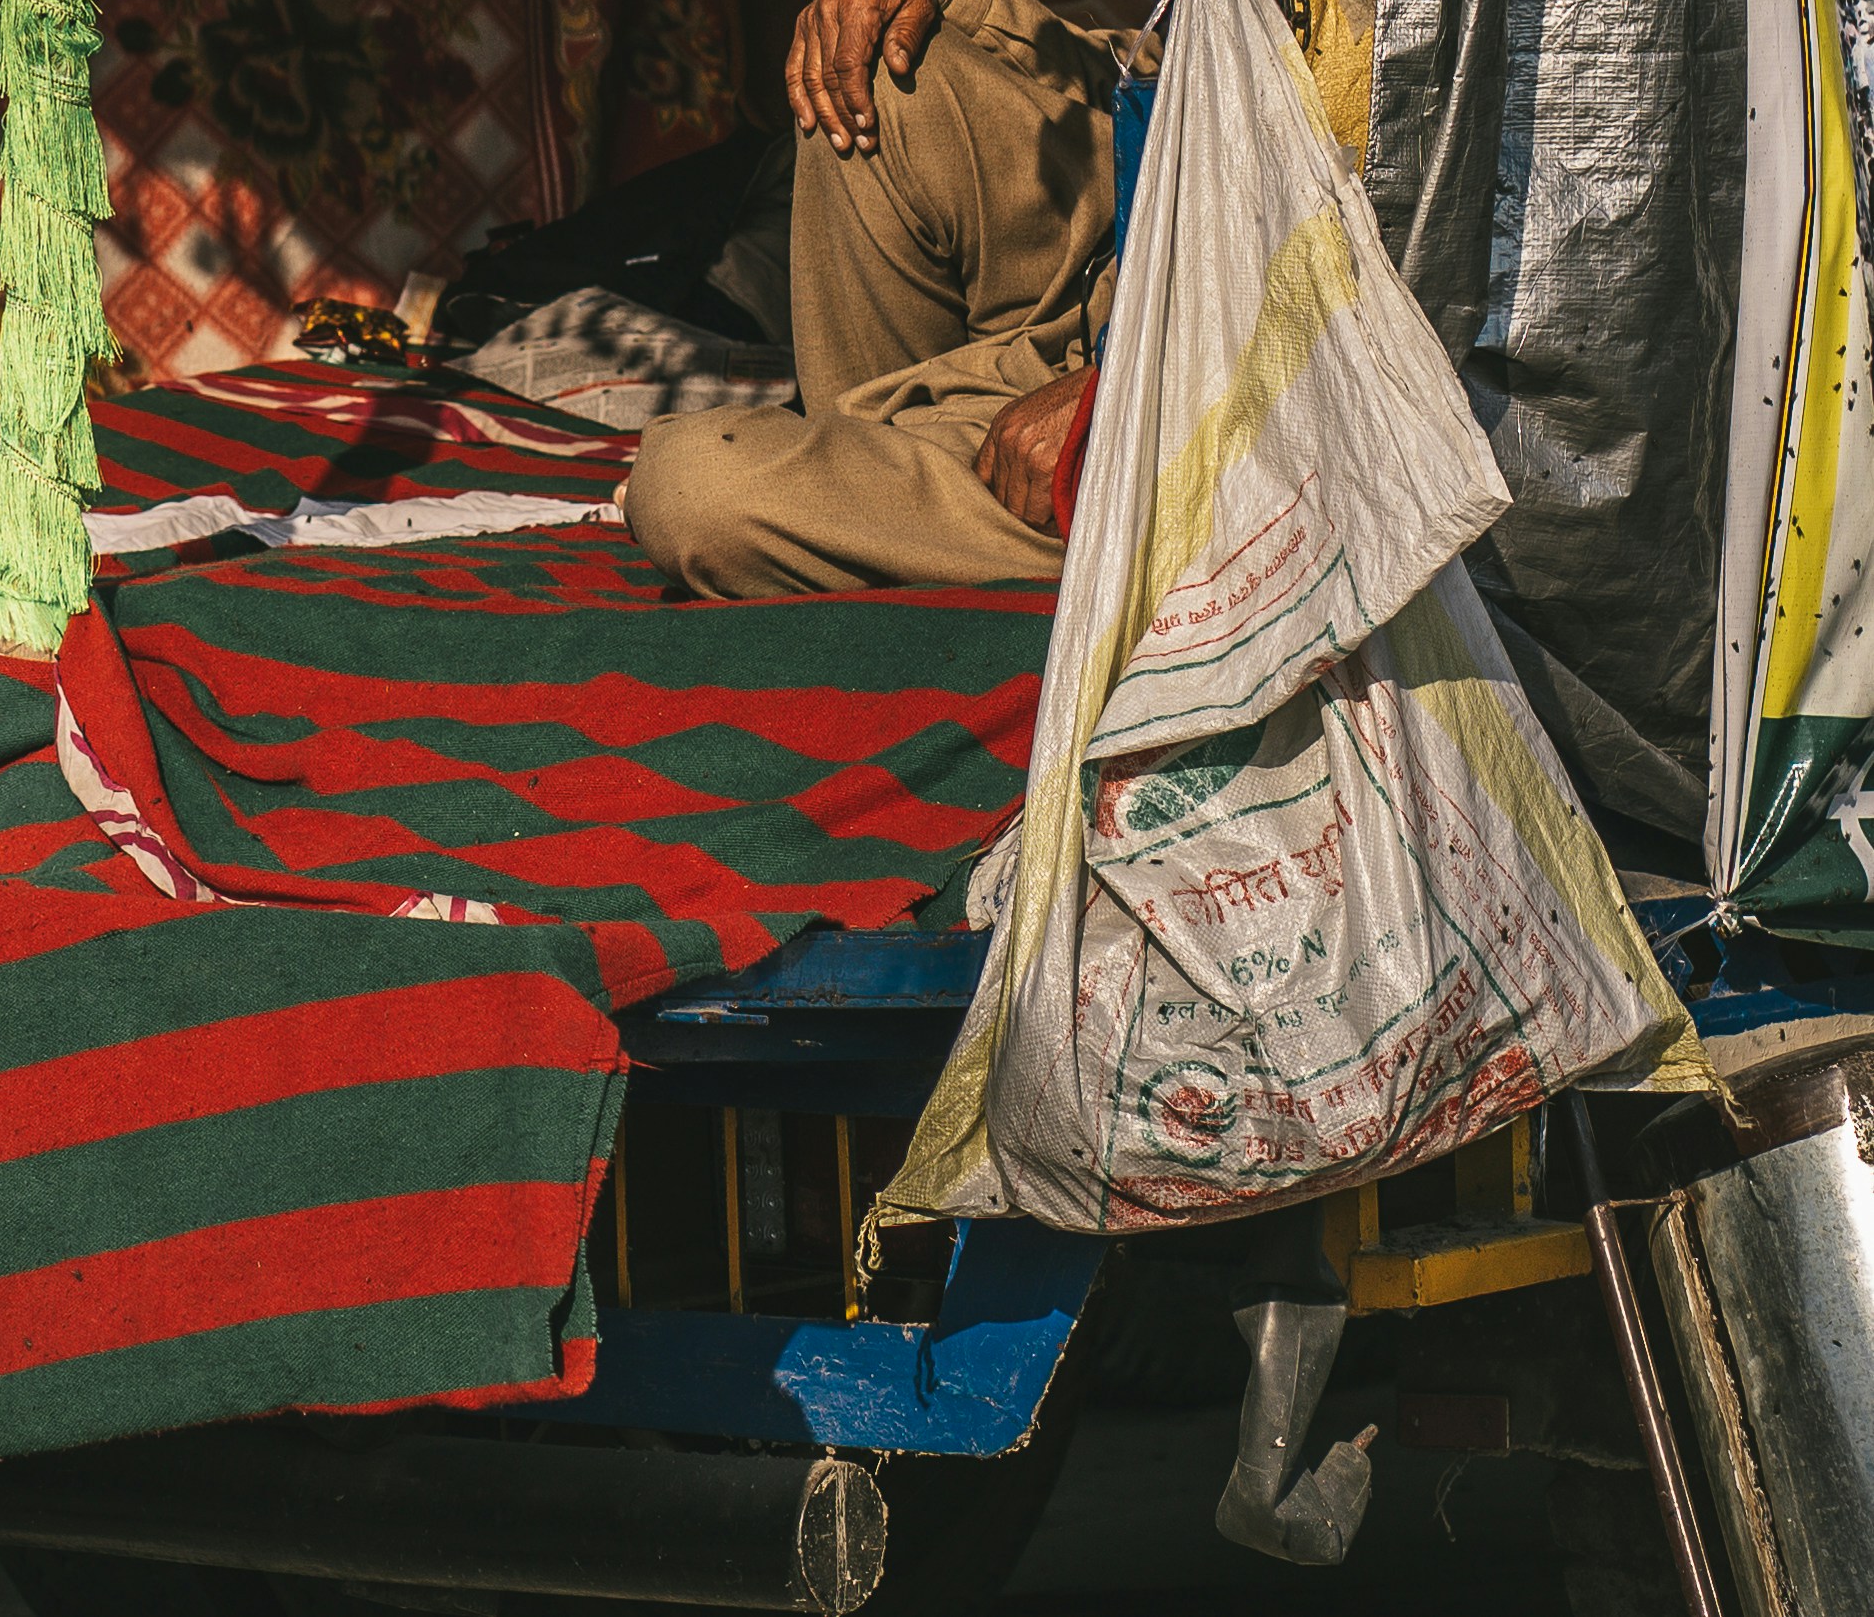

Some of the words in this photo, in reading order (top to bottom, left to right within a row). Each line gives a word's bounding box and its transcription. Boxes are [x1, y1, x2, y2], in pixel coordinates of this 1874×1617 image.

[1188, 600, 1224, 624] मूल्य
[1173, 861, 1289, 925] लेपित
[1217, 945, 1290, 986] 6%
[1299, 929, 1327, 963] N
[1157, 1001, 1198, 1025] कुल
